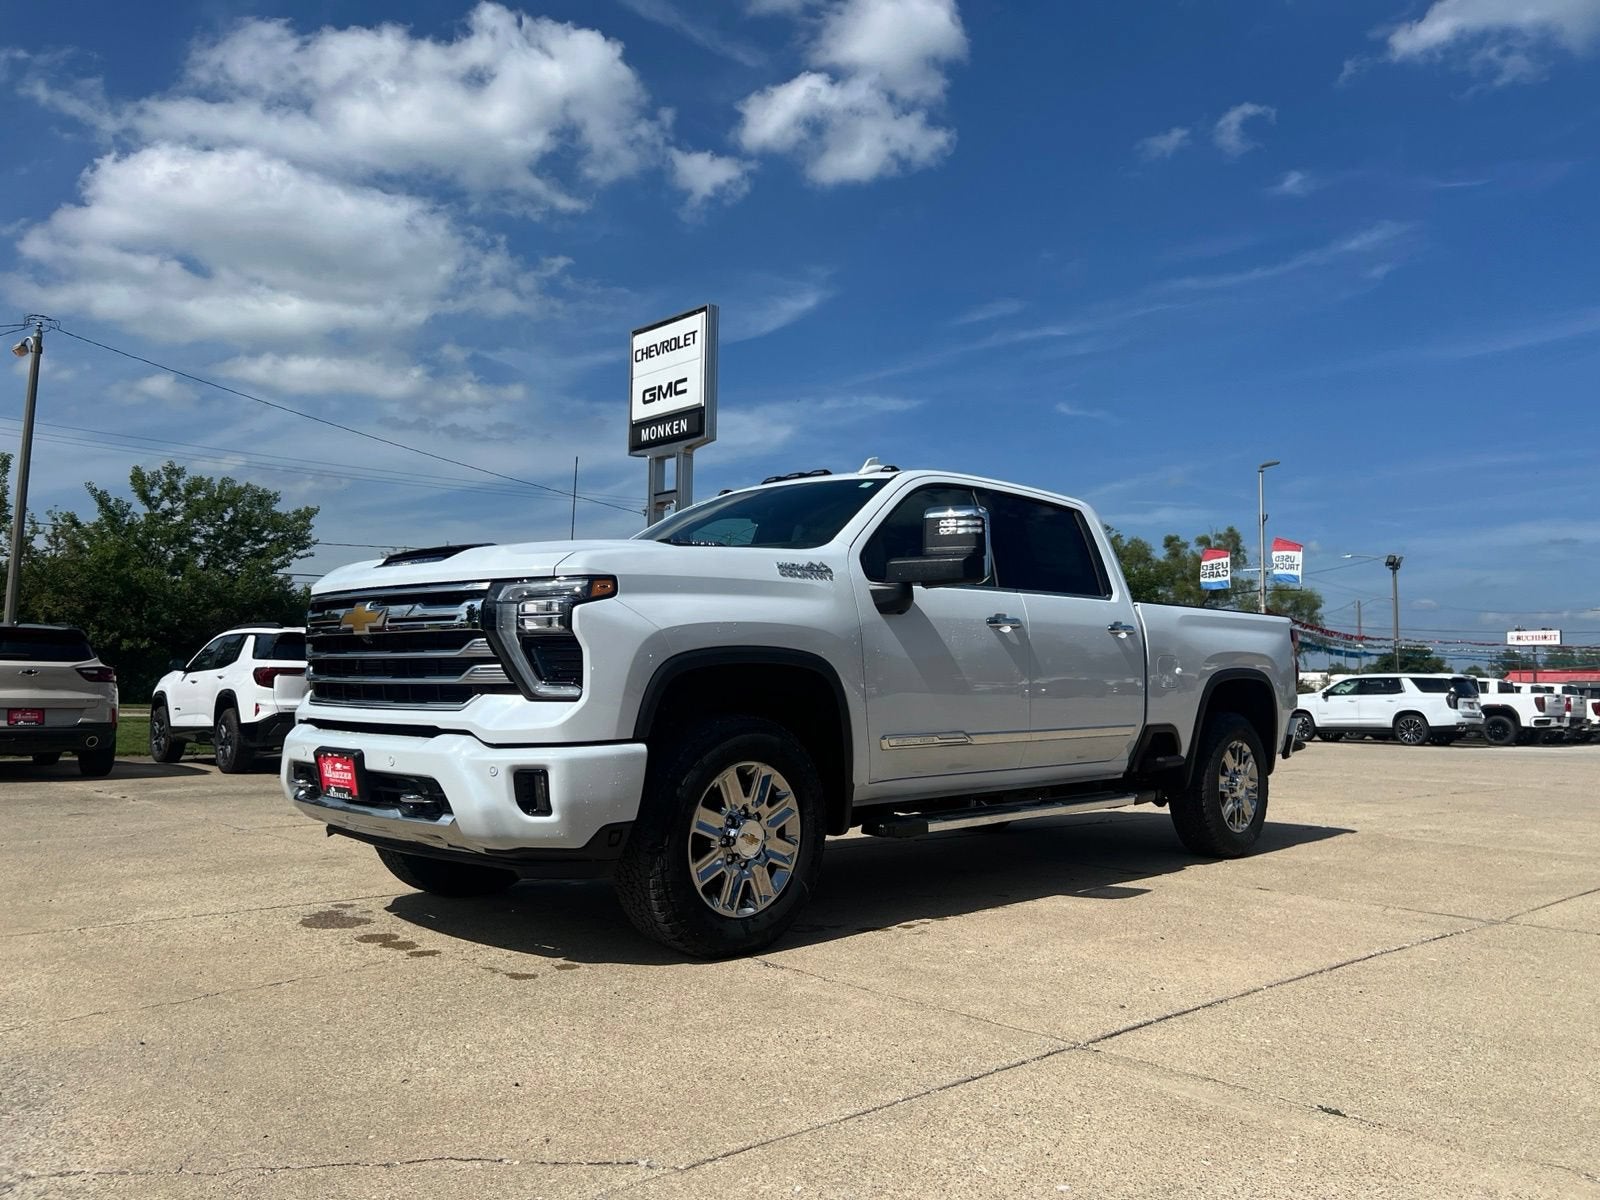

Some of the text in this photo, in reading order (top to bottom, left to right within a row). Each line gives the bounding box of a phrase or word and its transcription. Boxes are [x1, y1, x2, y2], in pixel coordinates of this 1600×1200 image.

[634, 330, 698, 362] CHEVROLET
[642, 377, 688, 405] GMC
[641, 418, 688, 441] MONKEN
